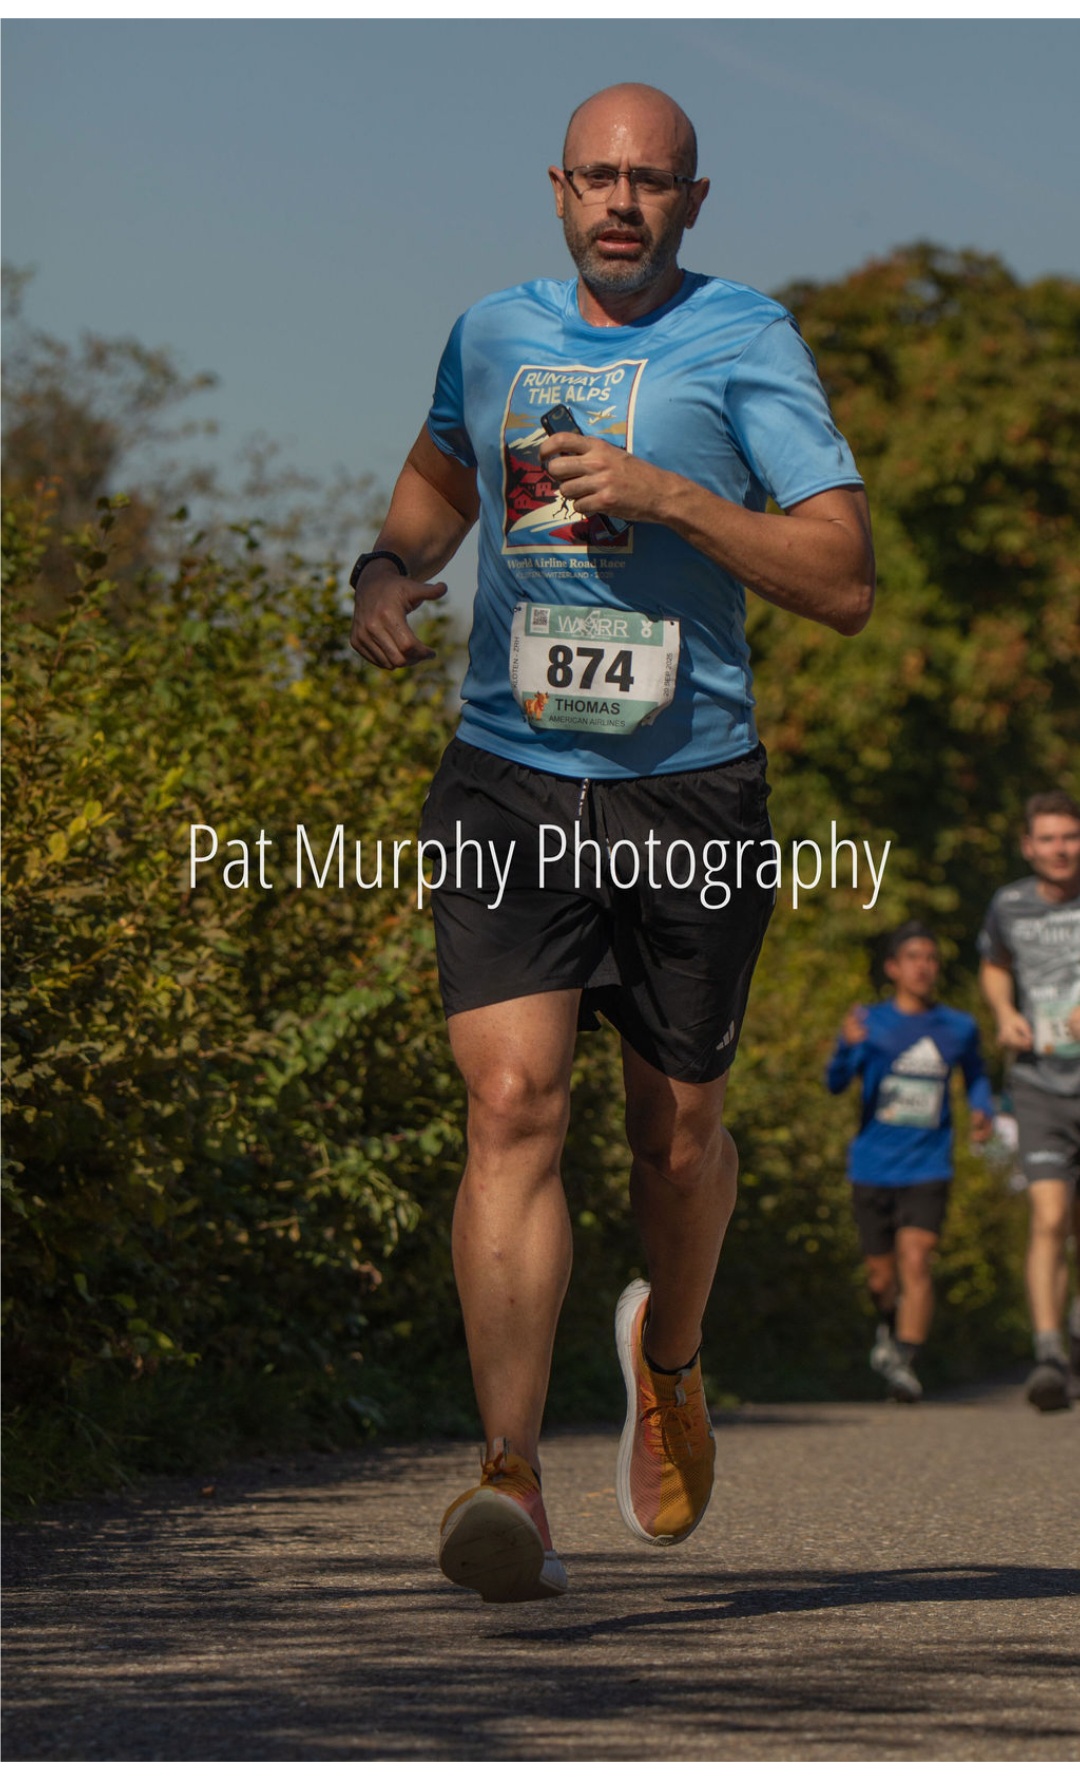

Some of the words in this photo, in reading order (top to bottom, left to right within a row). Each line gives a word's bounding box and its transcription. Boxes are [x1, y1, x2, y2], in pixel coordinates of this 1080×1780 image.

[523, 372, 601, 387] RUNWAY
[604, 369, 625, 387] TO
[528, 386, 561, 404] THE
[565, 385, 611, 402] ALPS
[507, 557, 533, 569] World
[532, 557, 567, 569] Airline
[569, 558, 596, 569] Road
[600, 558, 626, 569] Race
[543, 571, 589, 579] WITZERLAND
[546, 644, 635, 693] 874
[555, 698, 621, 715] THOMAS
[549, 714, 589, 726] AMERICAN
[590, 717, 626, 728] AIRLINES
